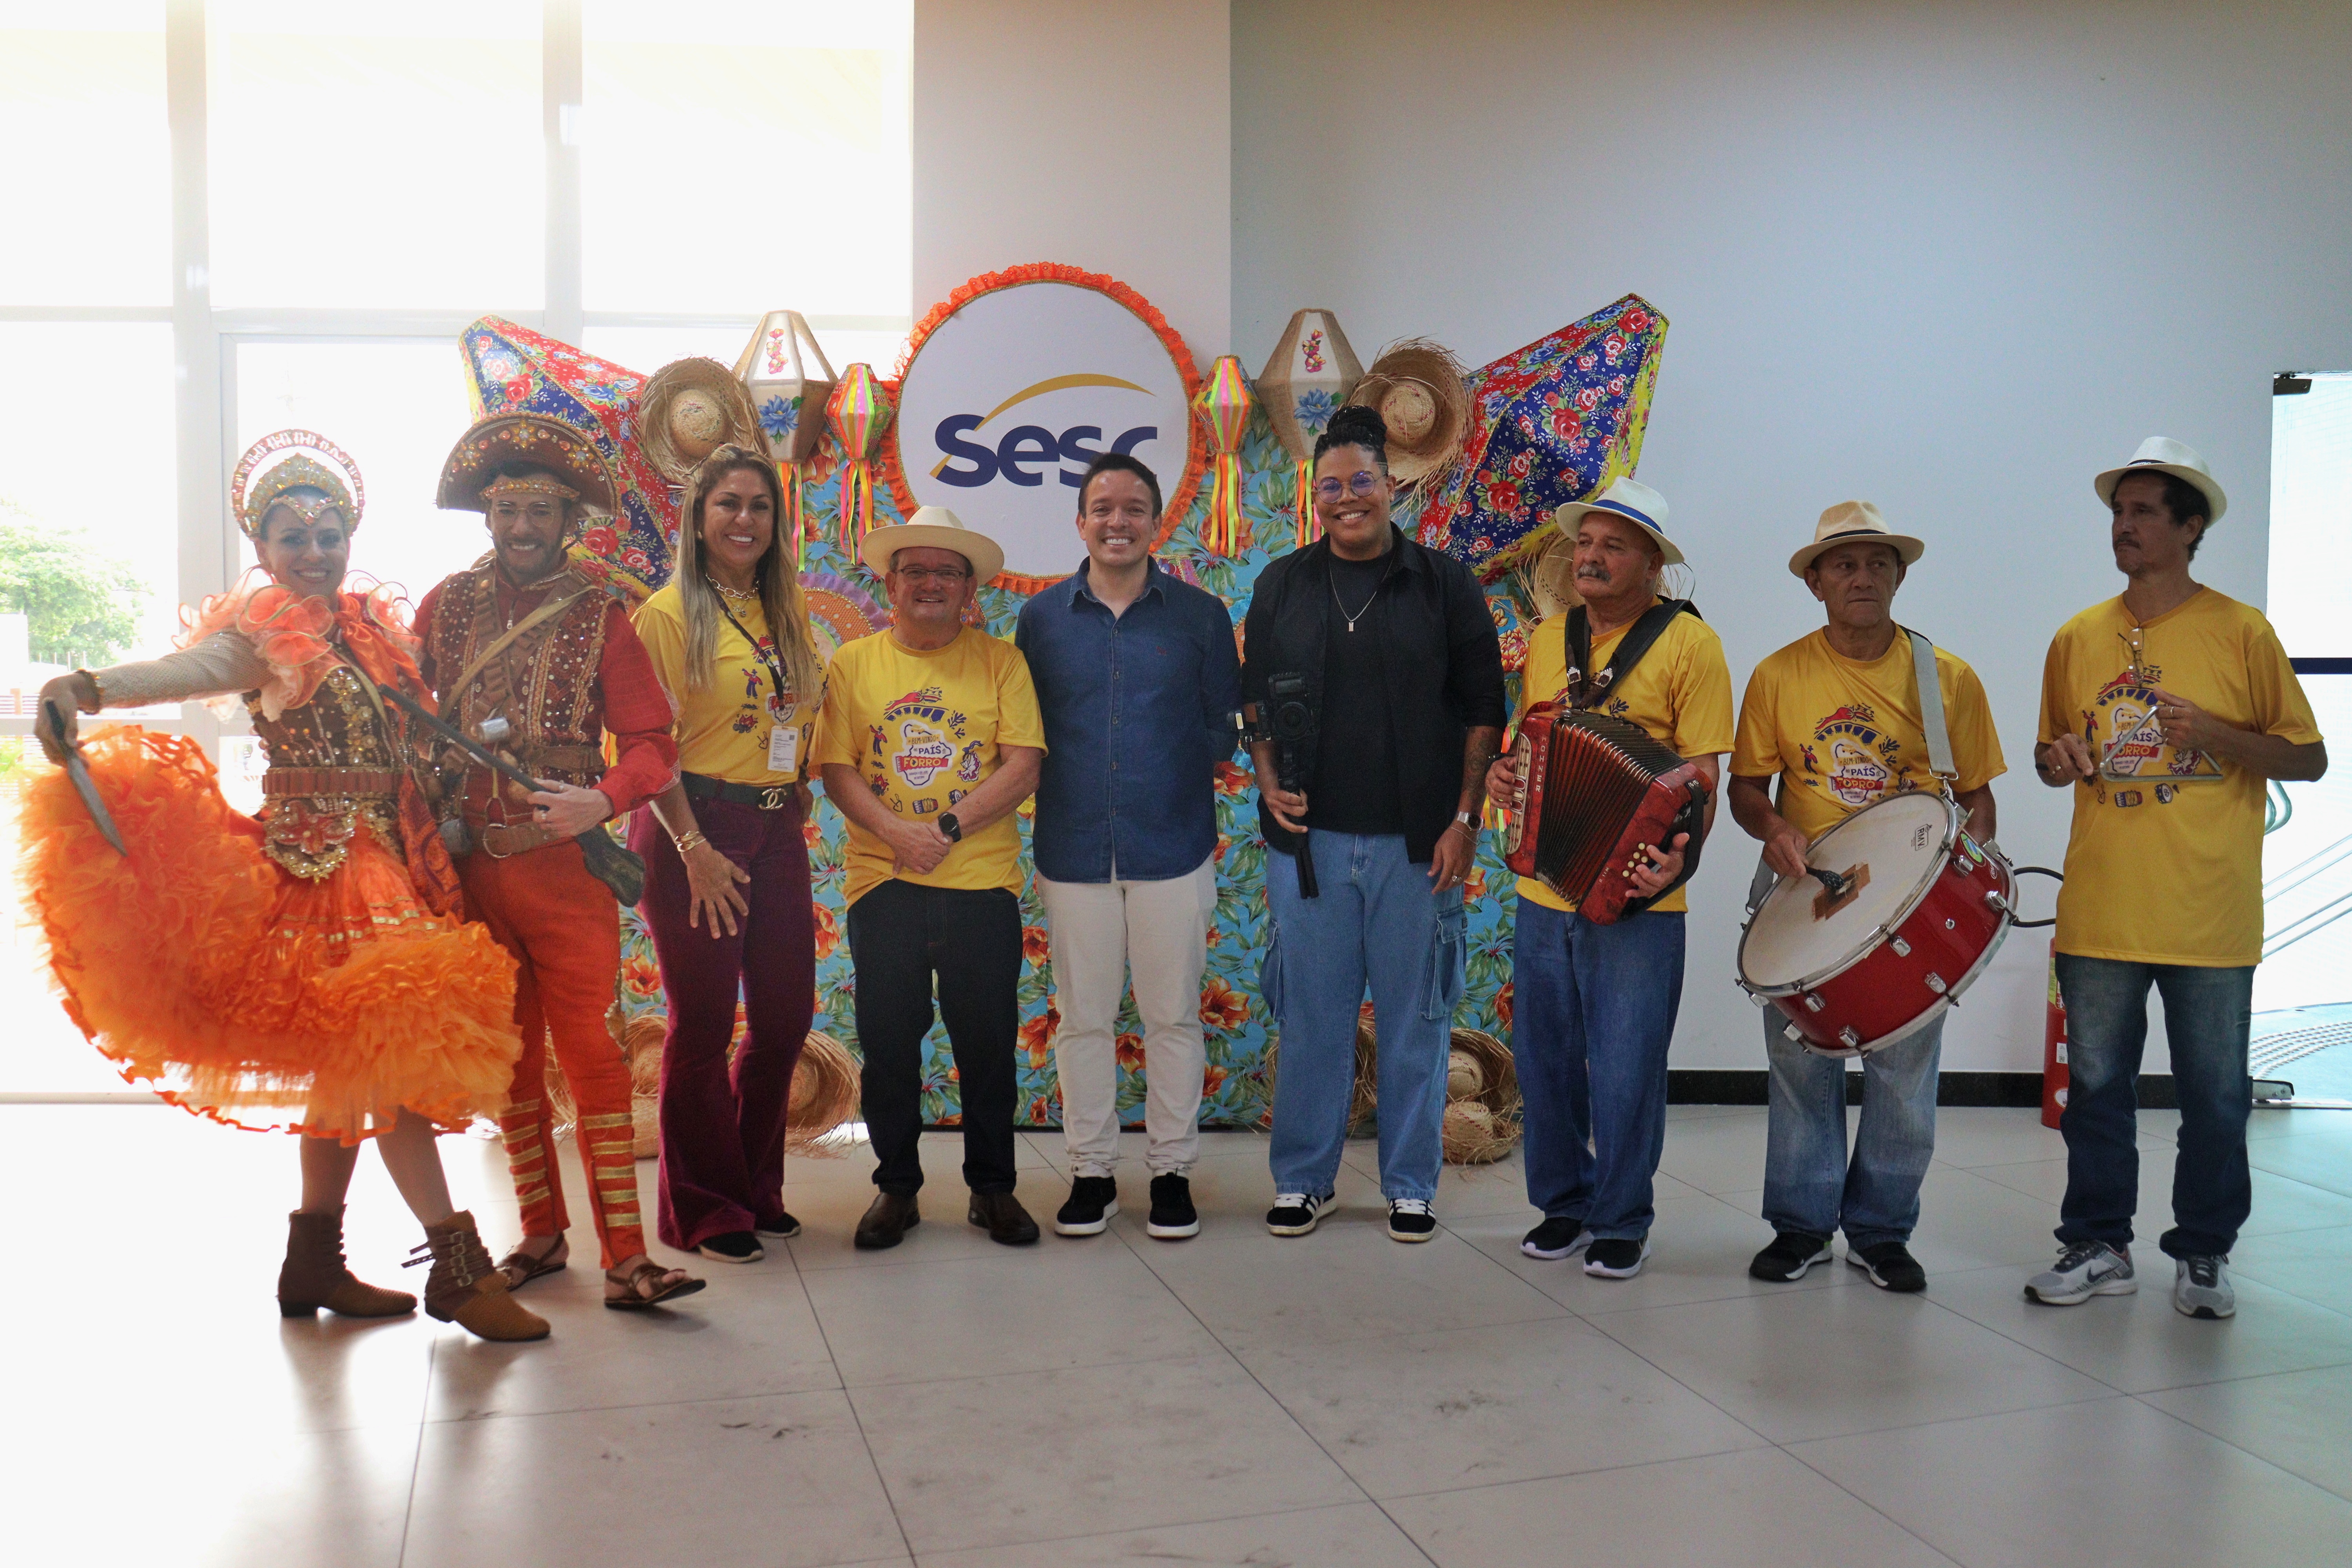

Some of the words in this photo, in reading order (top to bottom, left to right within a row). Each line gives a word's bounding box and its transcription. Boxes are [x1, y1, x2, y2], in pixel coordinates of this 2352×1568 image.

[912, 736, 936, 744] BEM-VINDO
[2132, 731, 2152, 742] AÍS
[919, 745, 941, 754] PAÍS
[1535, 737, 1547, 793] HOHNER
[1843, 757, 1869, 765] BEM-VINDO
[1851, 766, 1875, 776] PAÍS
